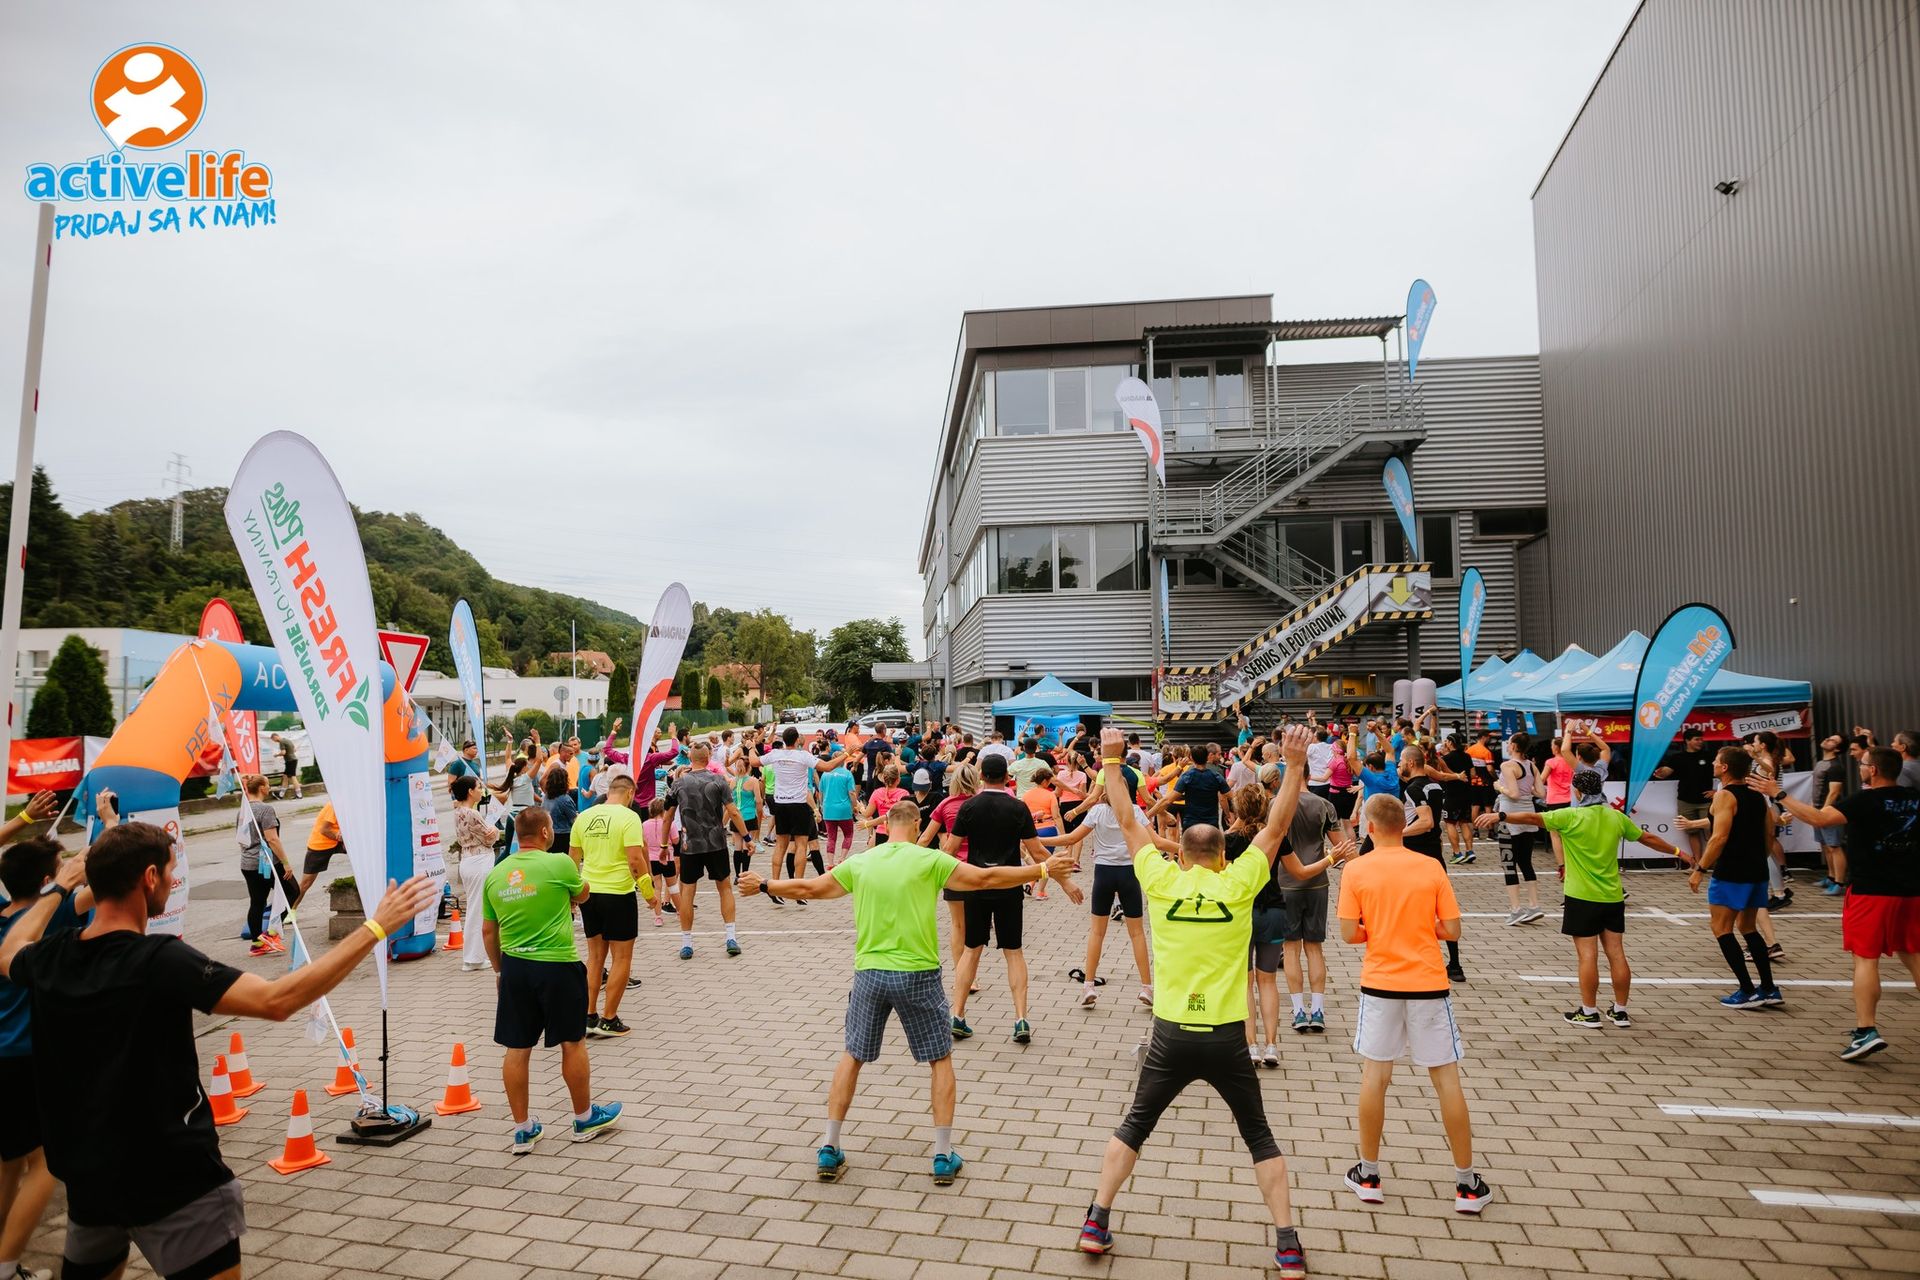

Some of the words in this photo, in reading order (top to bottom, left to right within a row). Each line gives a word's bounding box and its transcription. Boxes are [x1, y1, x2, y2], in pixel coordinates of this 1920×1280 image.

[1243, 649, 1281, 680] SERVIS
[1278, 642, 1291, 658] A
[1656, 624, 1723, 706] activelife
[1665, 683, 1692, 721] PRIDAJ
[1687, 672, 1702, 690] SA
[185, 682, 232, 762] REAX
[1188, 1004, 1206, 1012] RUN
